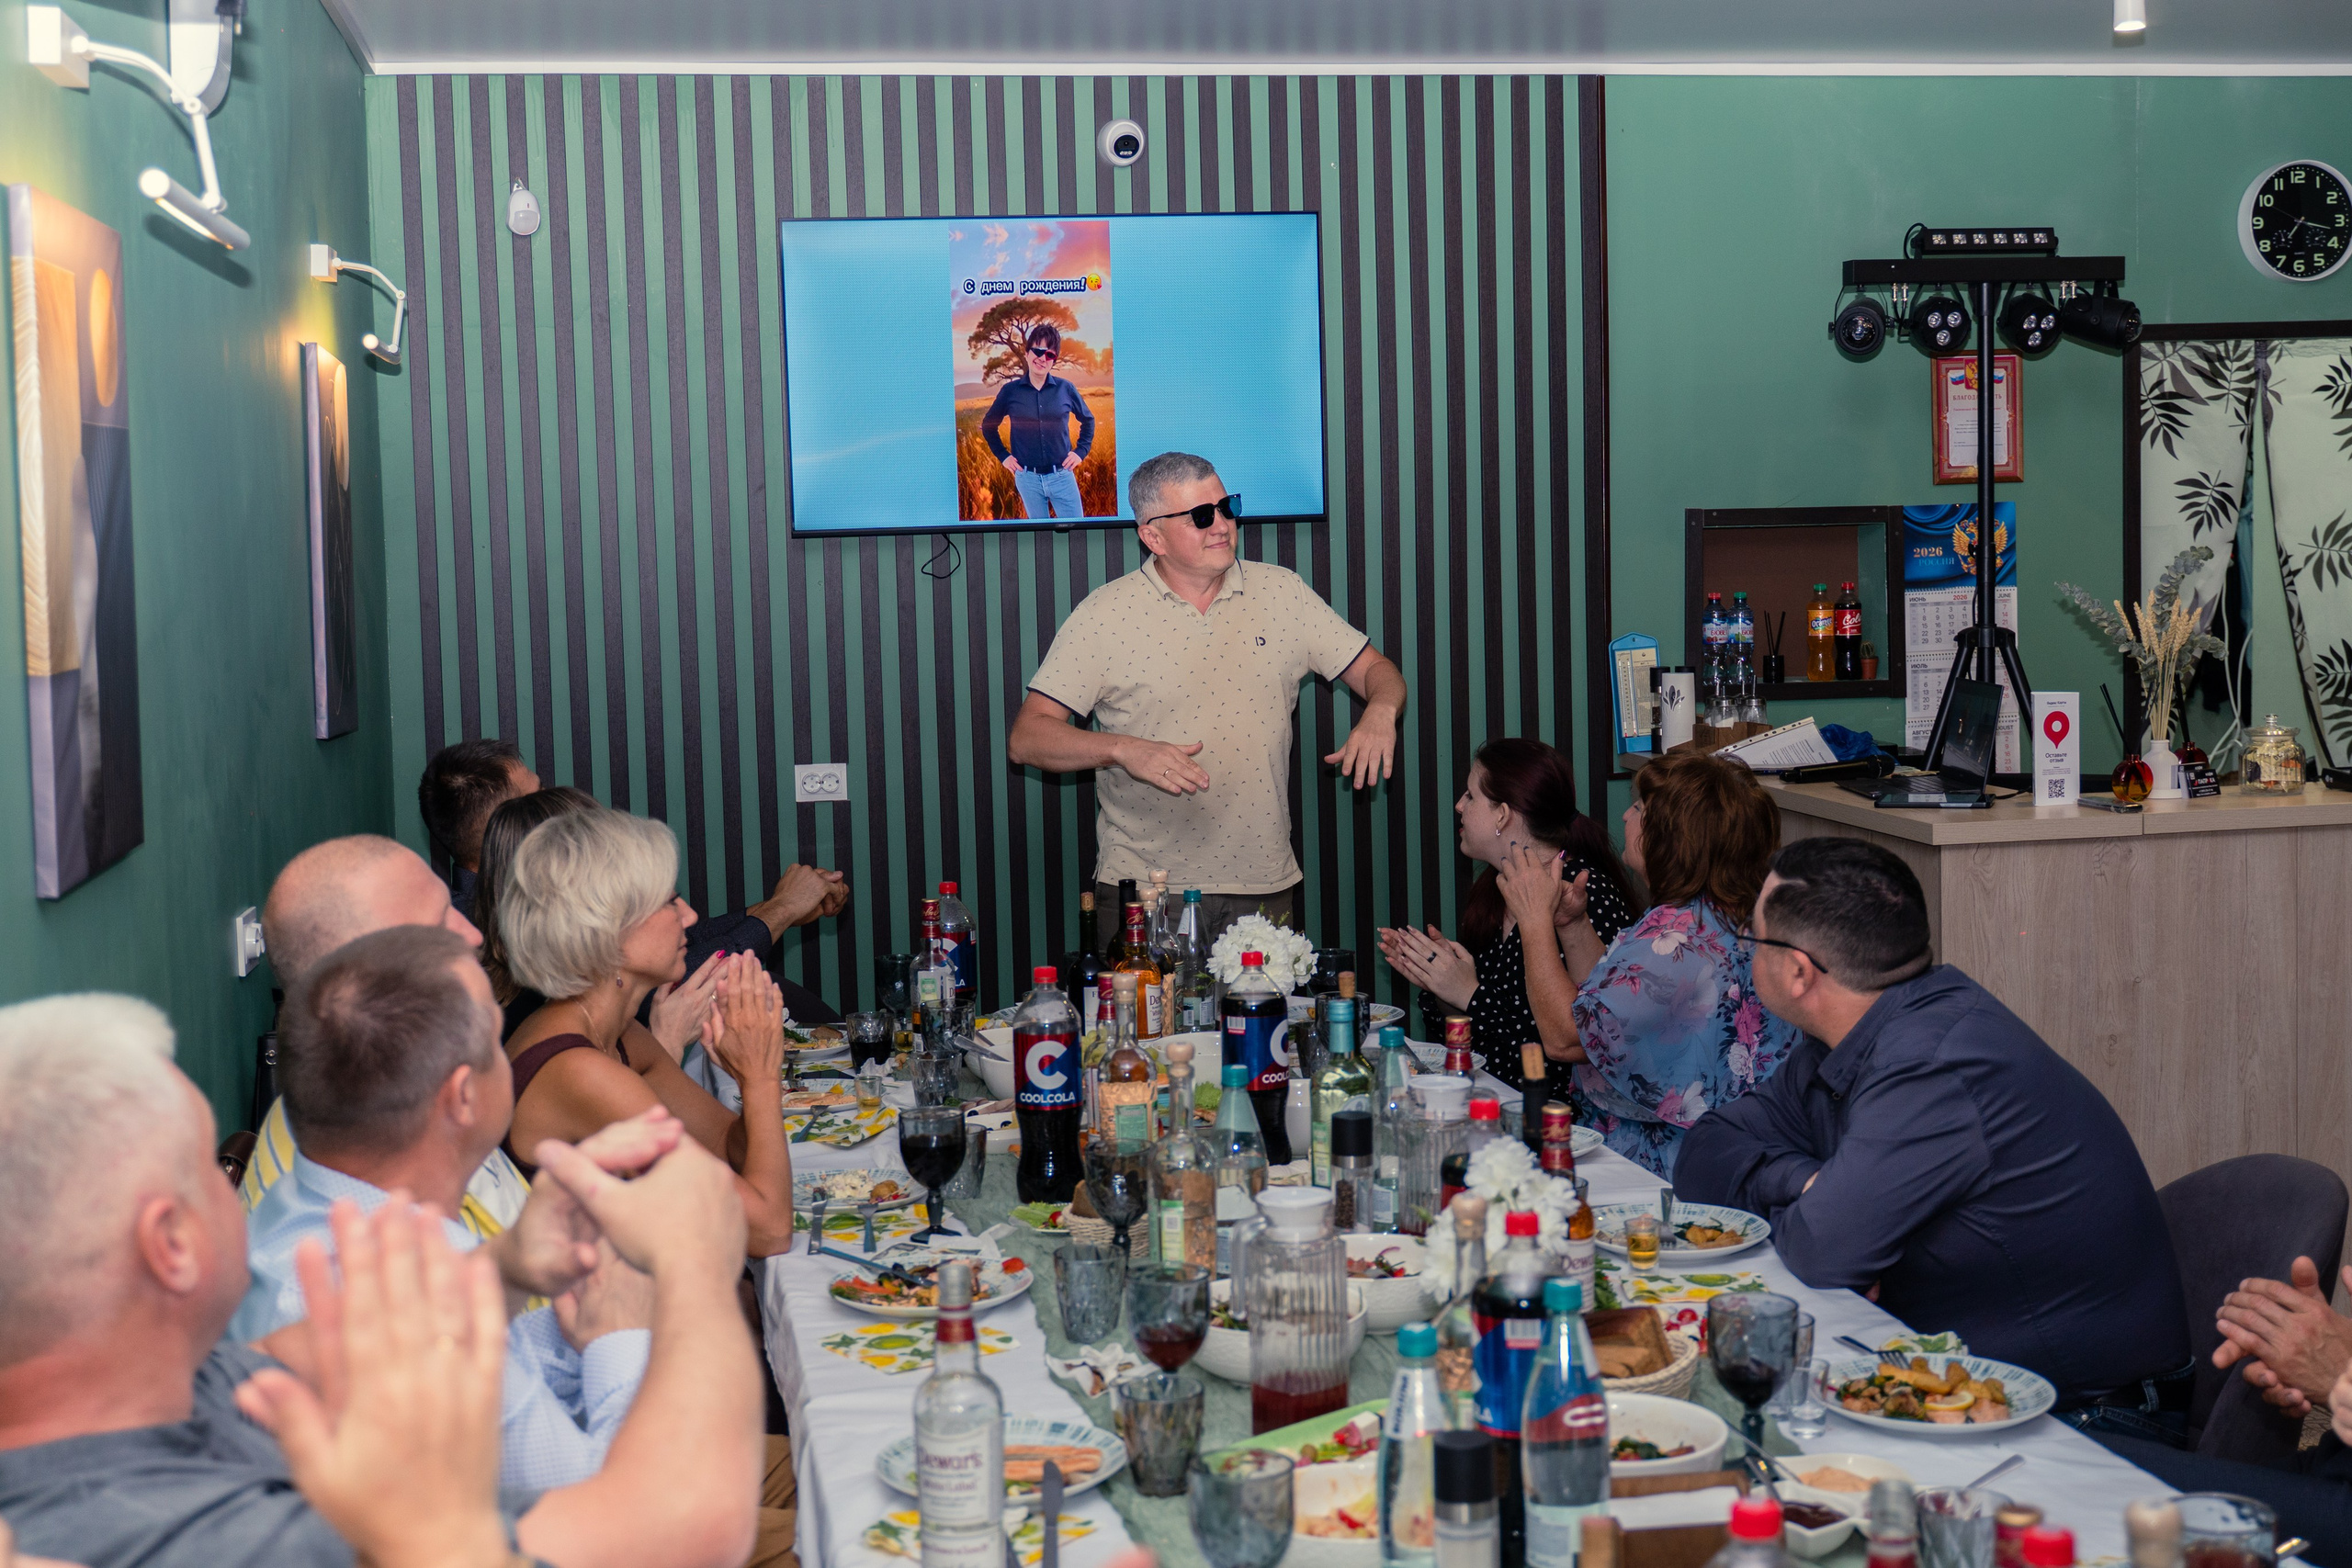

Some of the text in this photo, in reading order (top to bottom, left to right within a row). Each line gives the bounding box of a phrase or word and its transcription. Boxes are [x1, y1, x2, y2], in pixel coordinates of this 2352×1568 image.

[2290, 171, 2305, 183] 12
[2316, 176, 2320, 188] 1
[2275, 178, 2283, 190] 11
[2259, 195, 2274, 207] 10
[2326, 192, 2337, 204] 2
[2253, 217, 2264, 229] 9
[2335, 215, 2345, 226] 3
[2259, 241, 2271, 252] 8
[2327, 237, 2339, 248] 4
[2276, 255, 2286, 267] 7
[2313, 254, 2324, 265] 5
[2293, 260, 2305, 272] 6
[980, 280, 1014, 295] днем
[1020, 277, 1087, 295] рождения!
[1913, 547, 1943, 558] 2026
[1918, 558, 1954, 566] РОССИЯ
[1020, 1091, 1075, 1103] COOLCOLA
